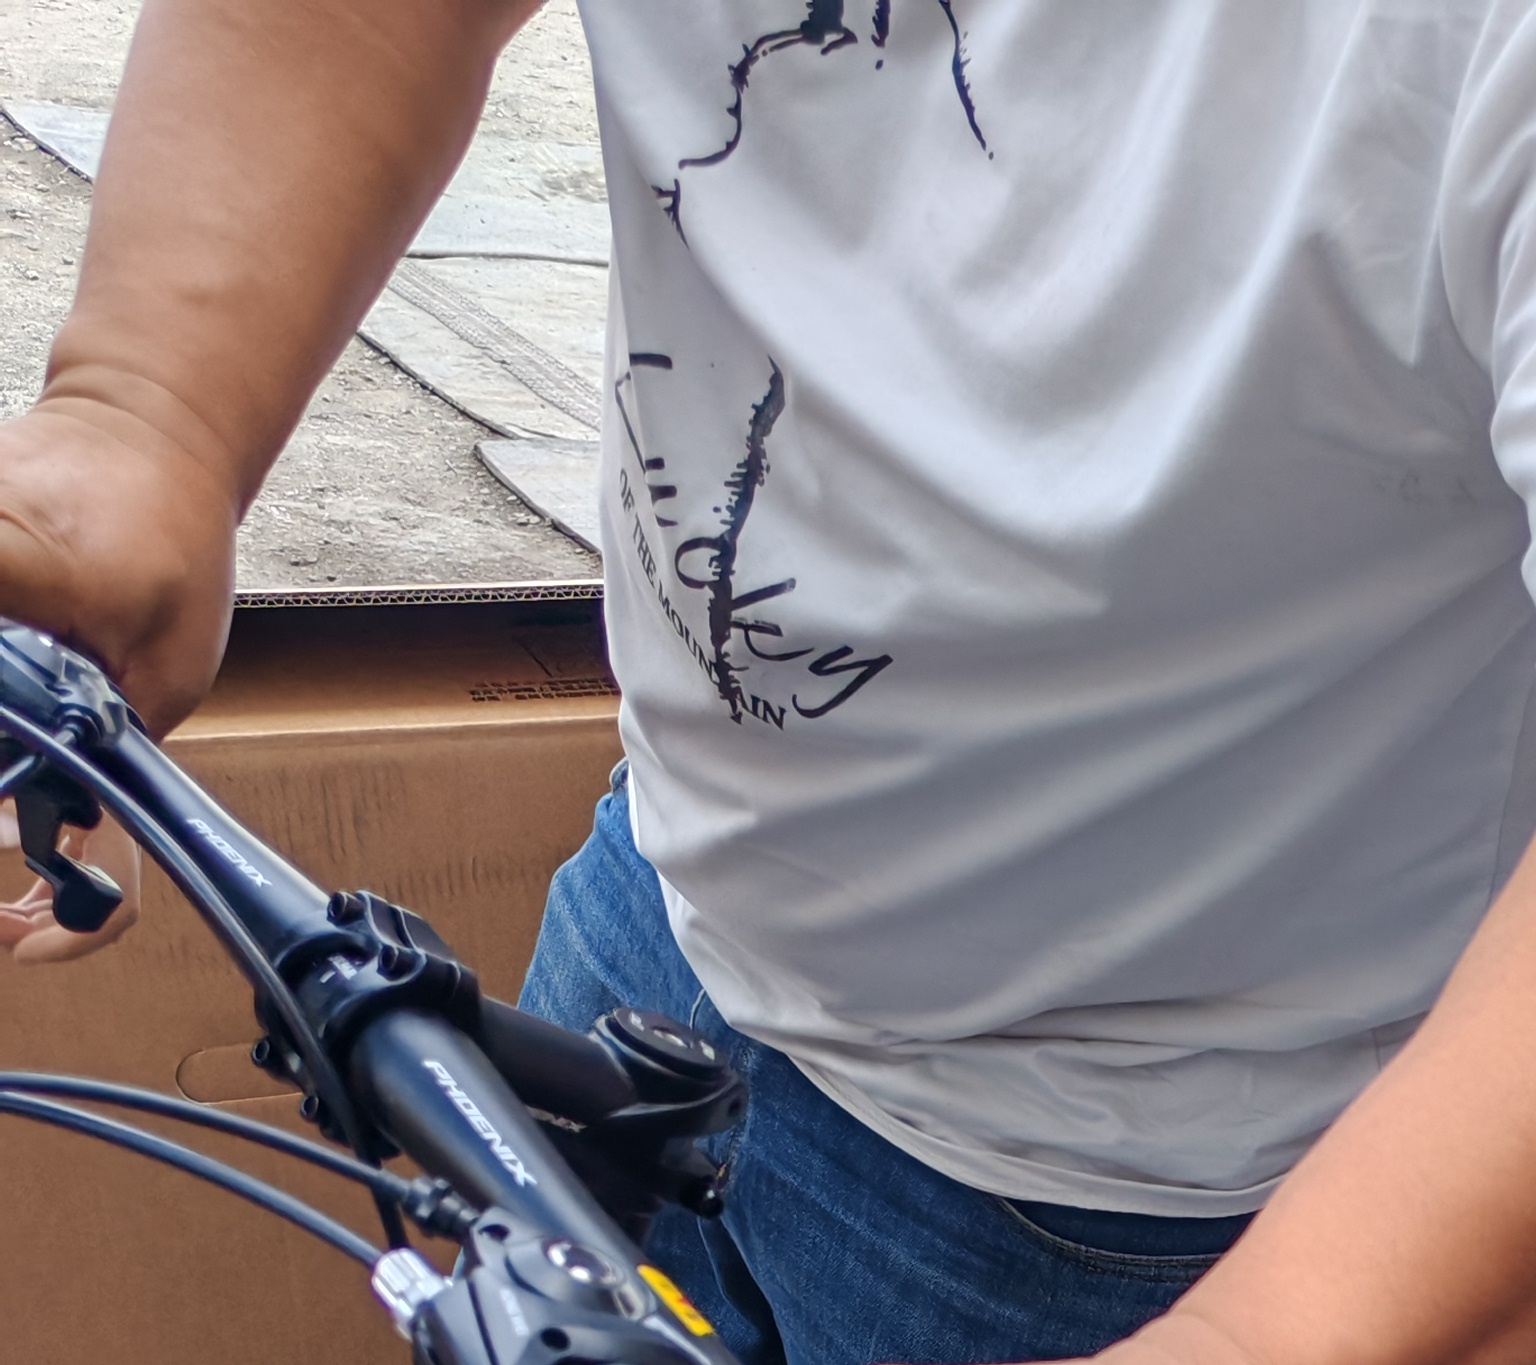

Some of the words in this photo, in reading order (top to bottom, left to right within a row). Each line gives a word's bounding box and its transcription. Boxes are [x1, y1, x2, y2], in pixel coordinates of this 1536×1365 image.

[632, 513, 656, 589] THE
[658, 580, 786, 731] MOUNAIN
[186, 818, 273, 887] PHOENIX
[422, 1060, 538, 1187] PHOENIX
